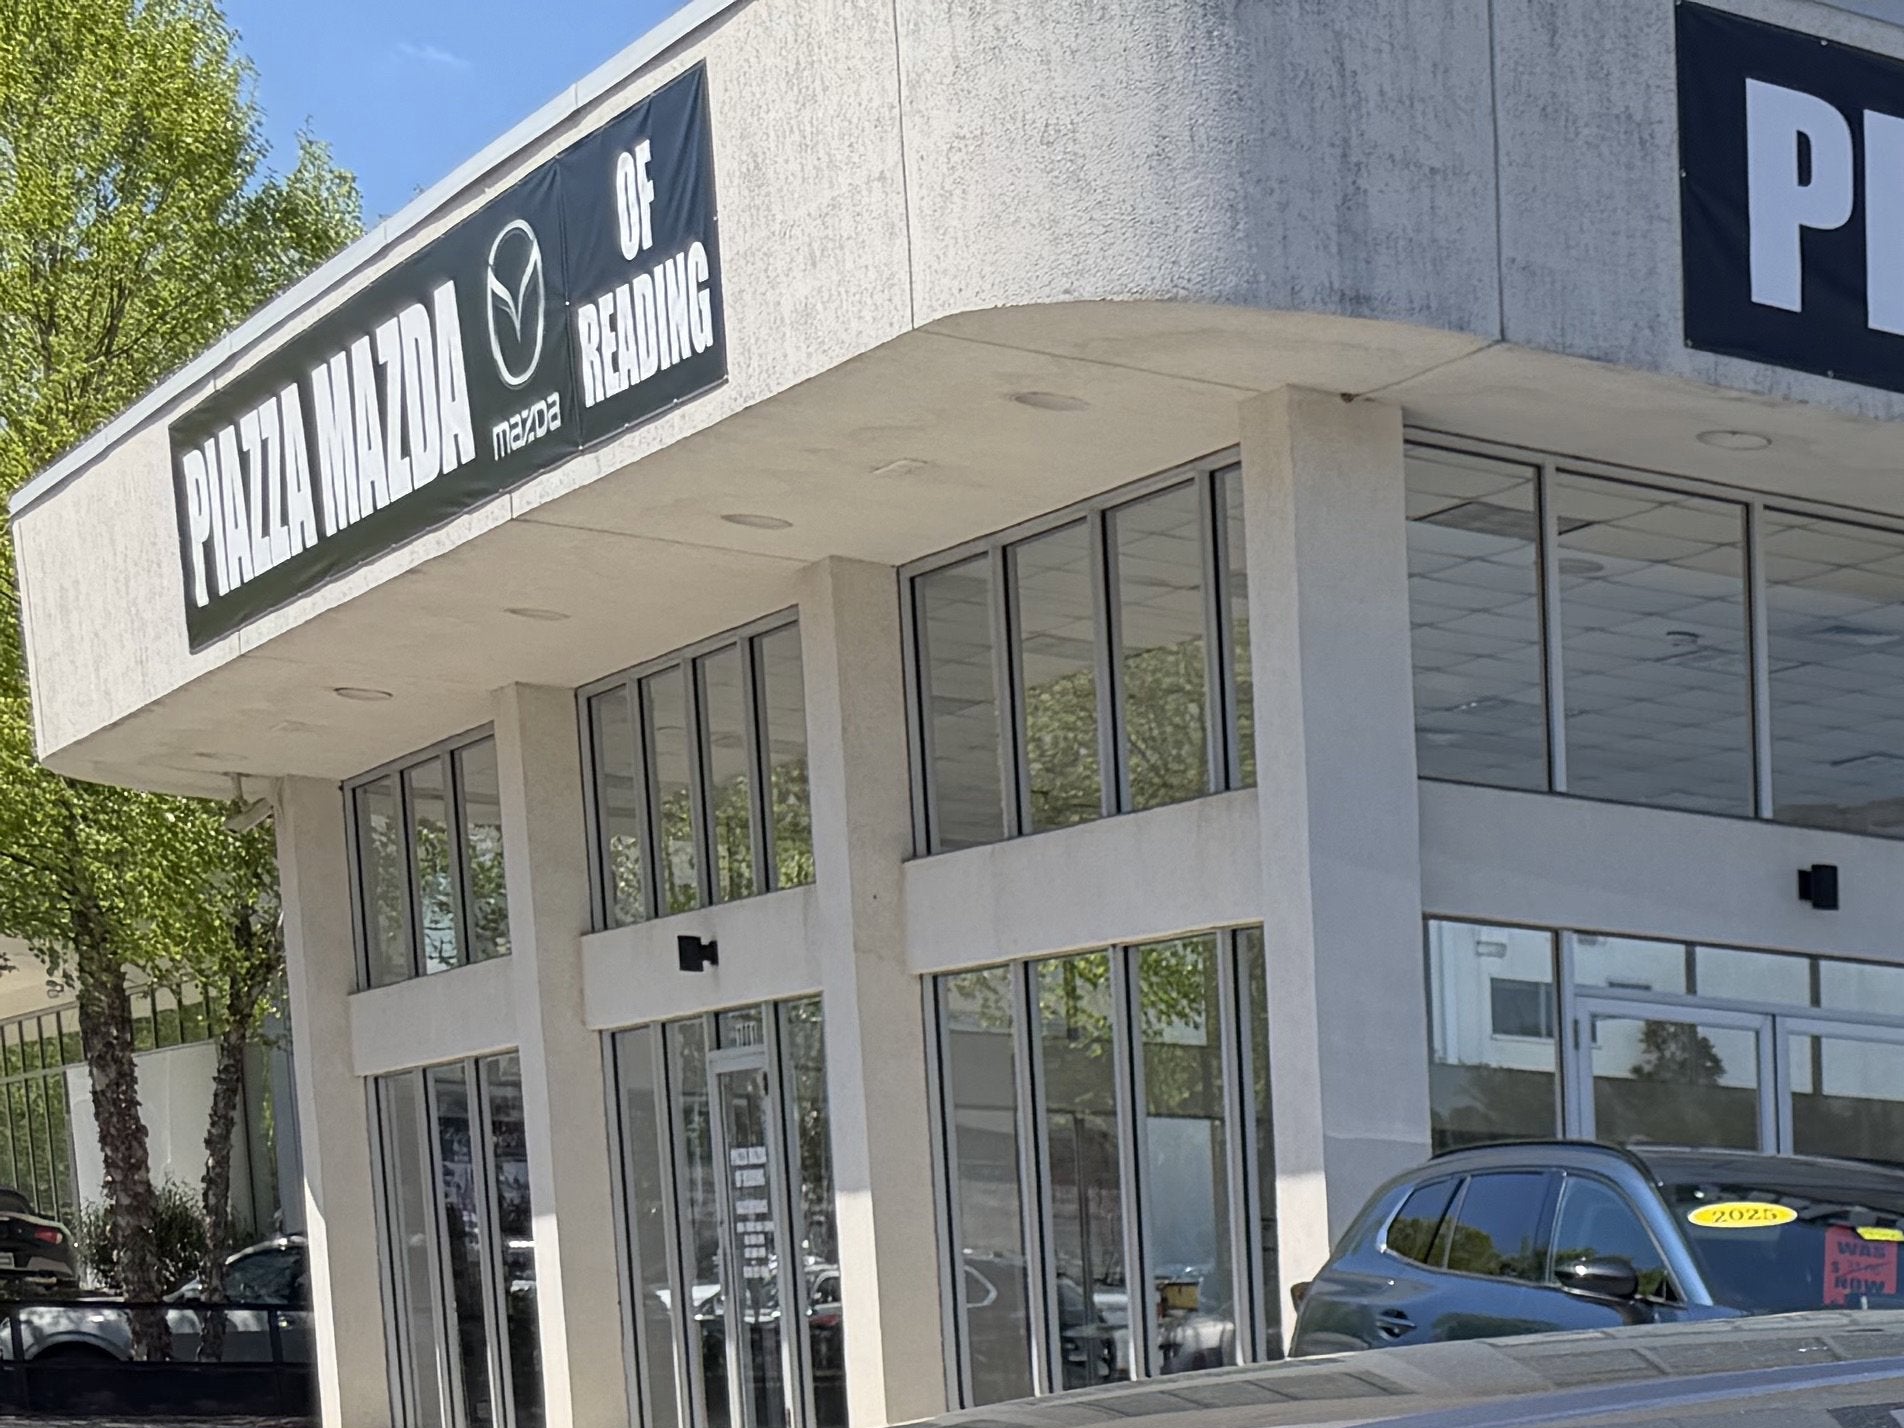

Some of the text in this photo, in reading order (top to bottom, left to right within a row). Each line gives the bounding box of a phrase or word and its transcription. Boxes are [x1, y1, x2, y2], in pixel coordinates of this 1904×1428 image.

[616, 140, 653, 260] OF
[576, 241, 714, 408] READING
[182, 280, 475, 608] PIAZZA MAZDA
[1712, 1208, 1778, 1225] 2025
[1837, 1241, 1886, 1259] WAS
